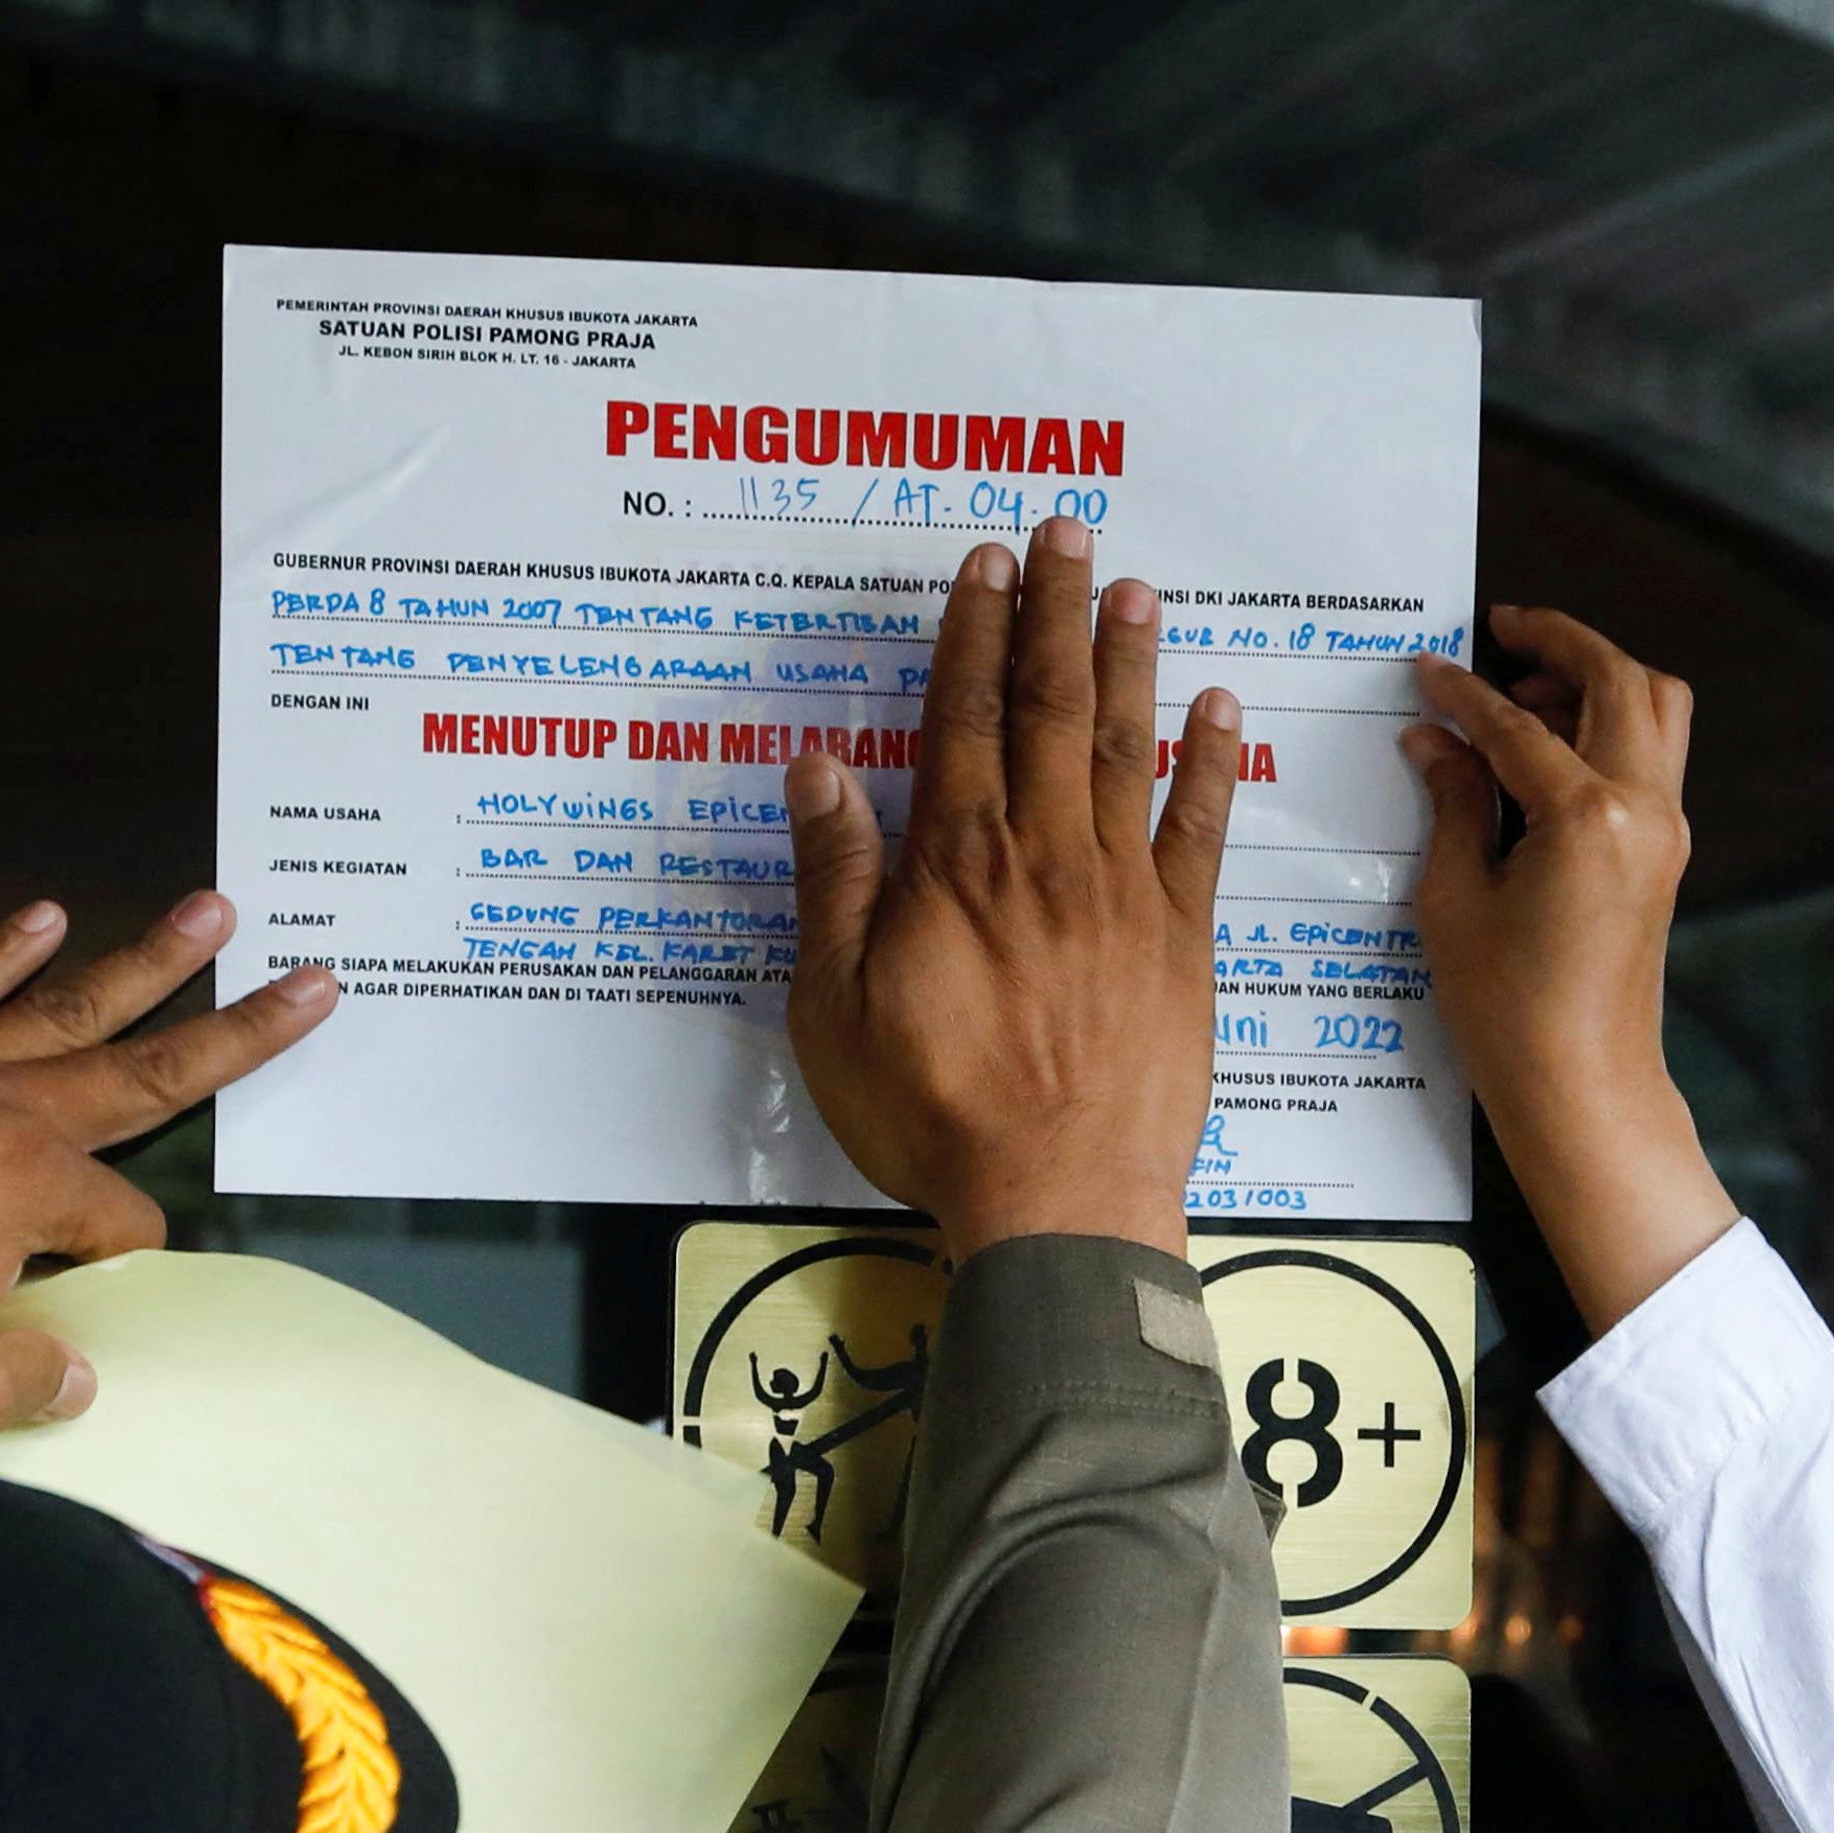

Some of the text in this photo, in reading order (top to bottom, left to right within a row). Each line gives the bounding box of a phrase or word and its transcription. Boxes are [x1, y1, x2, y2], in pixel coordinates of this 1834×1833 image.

[277, 299, 698, 327] PEMERINTAH PROVINSI DAERAH KHUSUS IBUKOTA JAKARTA
[319, 320, 656, 350] SATUAN POLISI PAMONG PRAJA
[338, 345, 359, 357] JL.
[363, 347, 413, 359] KEBON
[417, 349, 455, 361] SIRIH
[460, 351, 498, 363] BLOK
[503, 352, 516, 364] H.
[521, 354, 539, 365] LT.
[544, 354, 559, 366] 16
[572, 356, 636, 369] JAKARTA
[606, 400, 1125, 477] PENGUMUMAN
[623, 490, 674, 517] NO.
[273, 553, 1424, 613] GUBERNUR PROVINSI DAERAH KHUSUS IBUKOTA JAKARTA C.Q. KEPALA SATUAN PO INSI DKI JAKARTA BERDASARKAN
[271, 589, 360, 617] PERDA
[368, 587, 386, 617] 8
[502, 598, 564, 629] 2007
[1288, 622, 1317, 651] 18
[271, 694, 369, 711] DENGAN INI
[422, 712, 618, 759] MENUTUP
[628, 720, 709, 763] DAN
[270, 806, 381, 822] NAMA USAHA
[268, 860, 407, 876] JENIS KEGIATAN
[481, 847, 795, 881] BAR DAN RESTAUR
[268, 913, 336, 927] ALAMAT
[269, 956, 792, 984] BARANG SIAPA MELAKUKAN PERUSAKAN DAN PELANGGARAN ATA
[354, 982, 398, 997] AGAR
[404, 983, 523, 999] DIPERHATIKAN
[529, 986, 560, 1001] DAN
[565, 988, 581, 1001] DI
[586, 988, 631, 1002] TAATI
[636, 990, 747, 1006] SEPENUHNYA.
[1215, 982, 1424, 1000] AN HUKUM YANG BERLAKU
[1313, 1013, 1405, 1052] 2022
[1281, 1074, 1349, 1088] IBUKOTA
[1354, 1076, 1427, 1090] JAKARTA
[1214, 1097, 1338, 1112] PAMONG PRAJA
